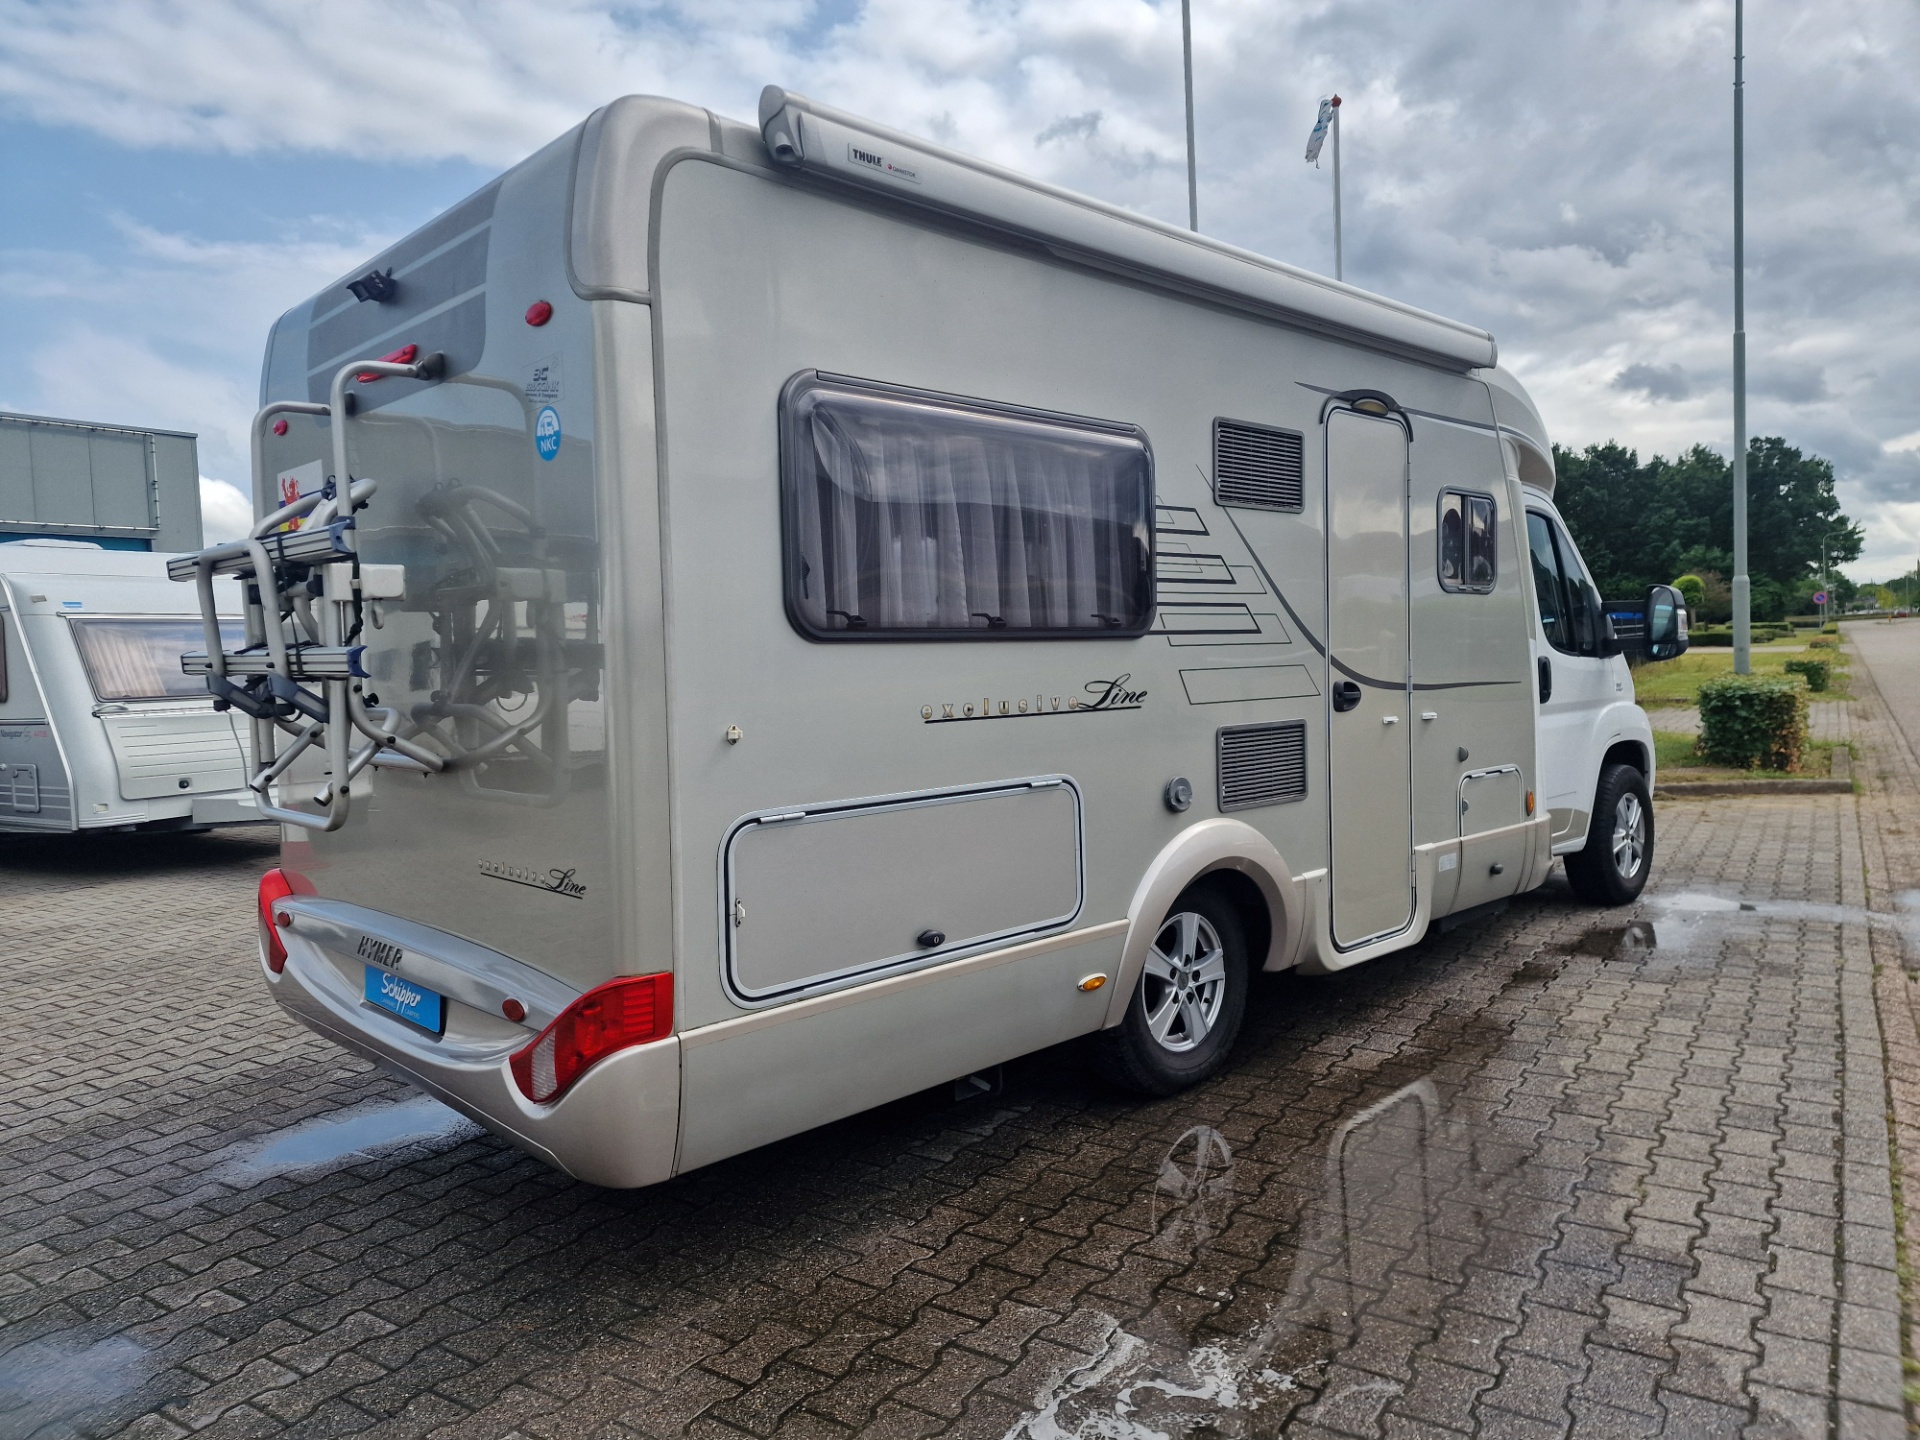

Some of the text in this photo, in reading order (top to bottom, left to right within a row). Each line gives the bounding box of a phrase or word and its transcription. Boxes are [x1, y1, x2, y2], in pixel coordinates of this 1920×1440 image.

[853, 149, 882, 167] THULE
[541, 437, 557, 453] NKC
[920, 673, 1147, 719] exclusive Line
[357, 935, 403, 970] HYMER
[381, 973, 421, 1014] Schipper
